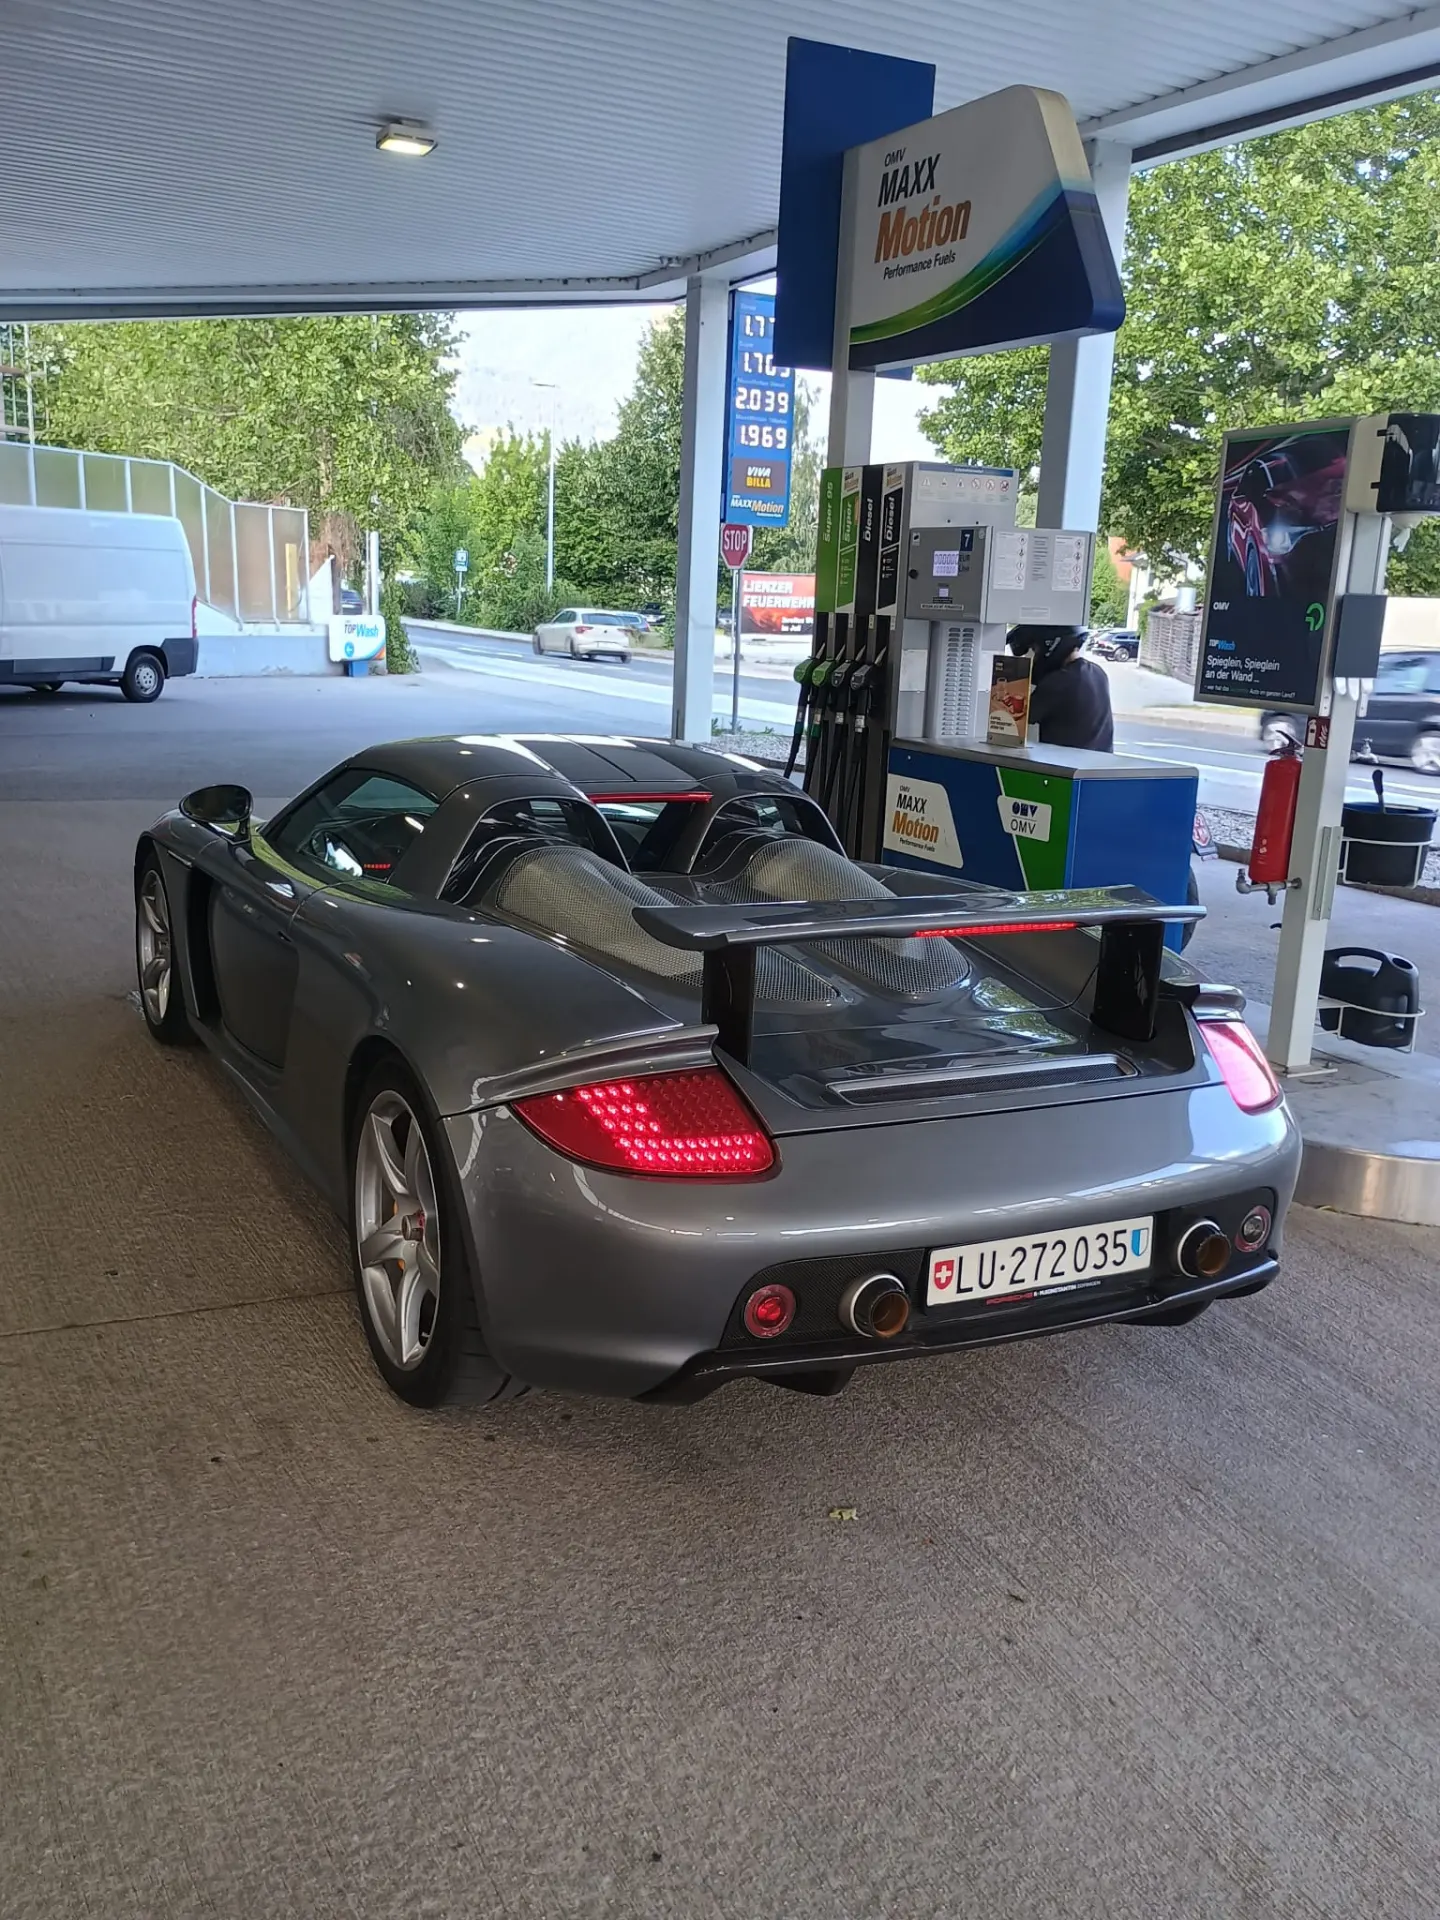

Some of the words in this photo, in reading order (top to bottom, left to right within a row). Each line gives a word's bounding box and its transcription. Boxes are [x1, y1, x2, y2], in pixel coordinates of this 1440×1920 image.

[884, 147, 907, 167] OMV
[877, 153, 942, 208] MAXX
[874, 194, 972, 264] Motion
[883, 258, 933, 280] Performance
[933, 249, 957, 268] Fuels
[735, 386, 789, 414] 2.039
[740, 424, 787, 450] 1.969
[746, 476, 771, 488] BILLA
[747, 466, 771, 477] VIVA
[824, 502, 833, 542] Super
[864, 498, 874, 542] Diesel
[886, 496, 895, 541] Diesel
[724, 530, 747, 551] STOP
[964, 533, 971, 548] 7
[1213, 602, 1230, 610] OMV
[1207, 655, 1243, 669] Spieglein,
[1244, 658, 1280, 672] Spieglein
[1205, 670, 1215, 679] an
[1217, 670, 1230, 680] der
[1231, 671, 1254, 682] Wand
[896, 793, 928, 814] MAXX
[892, 810, 940, 843] Motion
[1010, 819, 1036, 835] OMV
